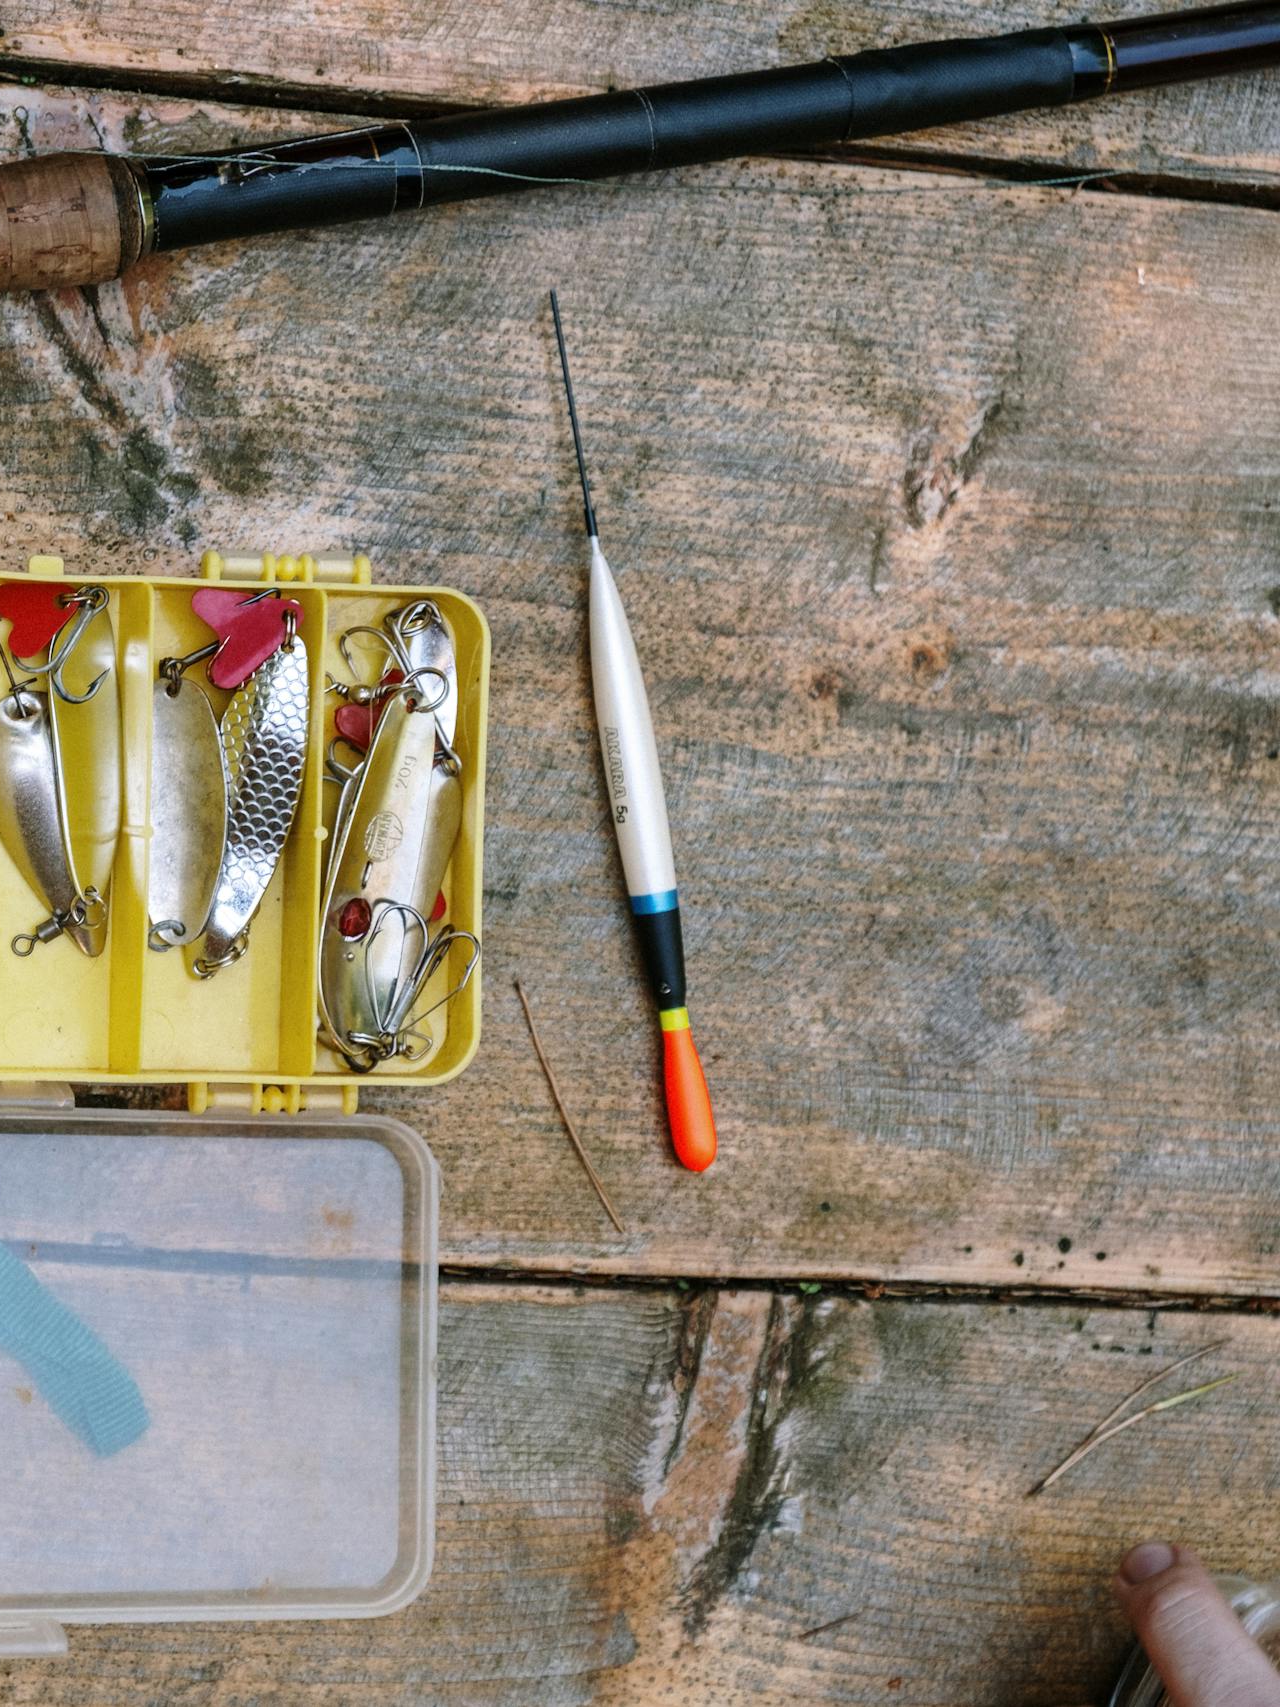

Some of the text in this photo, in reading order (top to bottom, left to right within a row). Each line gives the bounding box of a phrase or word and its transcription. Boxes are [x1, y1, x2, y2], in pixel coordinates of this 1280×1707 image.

[395, 755, 418, 789] 20g
[604, 726, 628, 824] AKARA 5g
